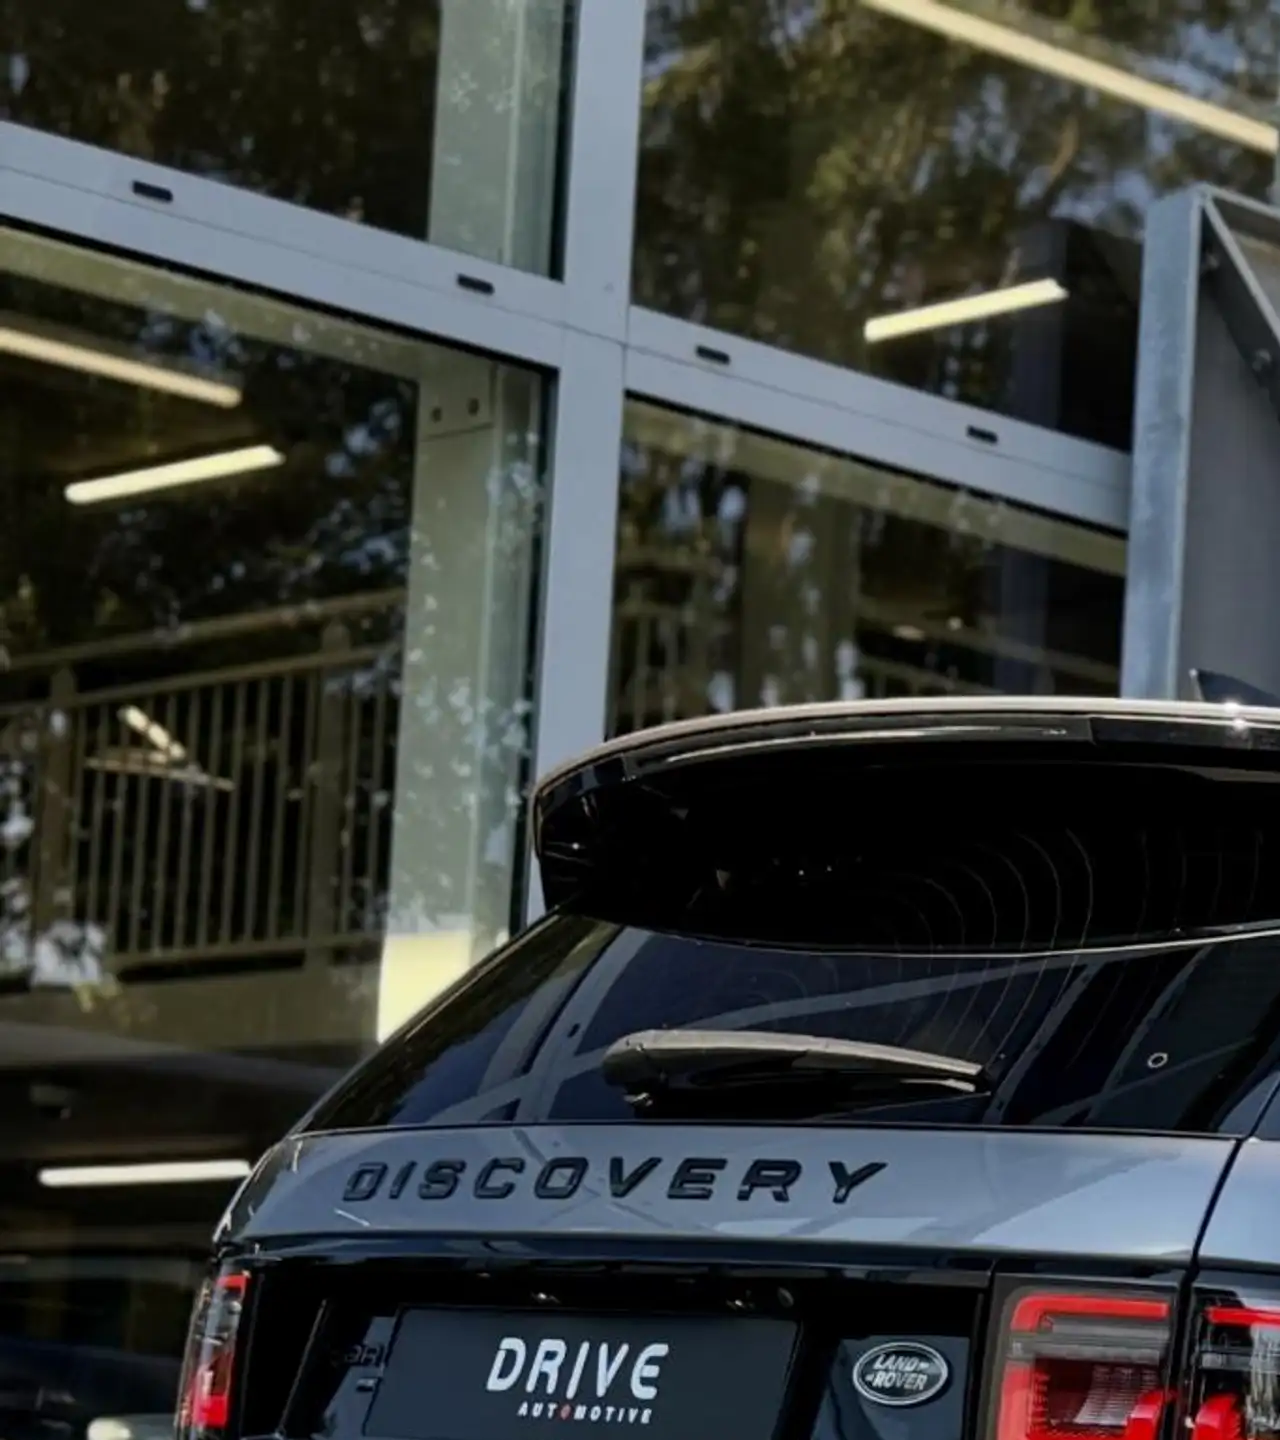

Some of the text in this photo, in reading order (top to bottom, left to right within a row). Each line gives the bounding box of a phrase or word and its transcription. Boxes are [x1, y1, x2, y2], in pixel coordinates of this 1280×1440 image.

[343, 1157, 887, 1203] DISCOVERY
[486, 1337, 669, 1400] DRIVE
[873, 1354, 919, 1372] LAND
[872, 1371, 927, 1390] ROVER
